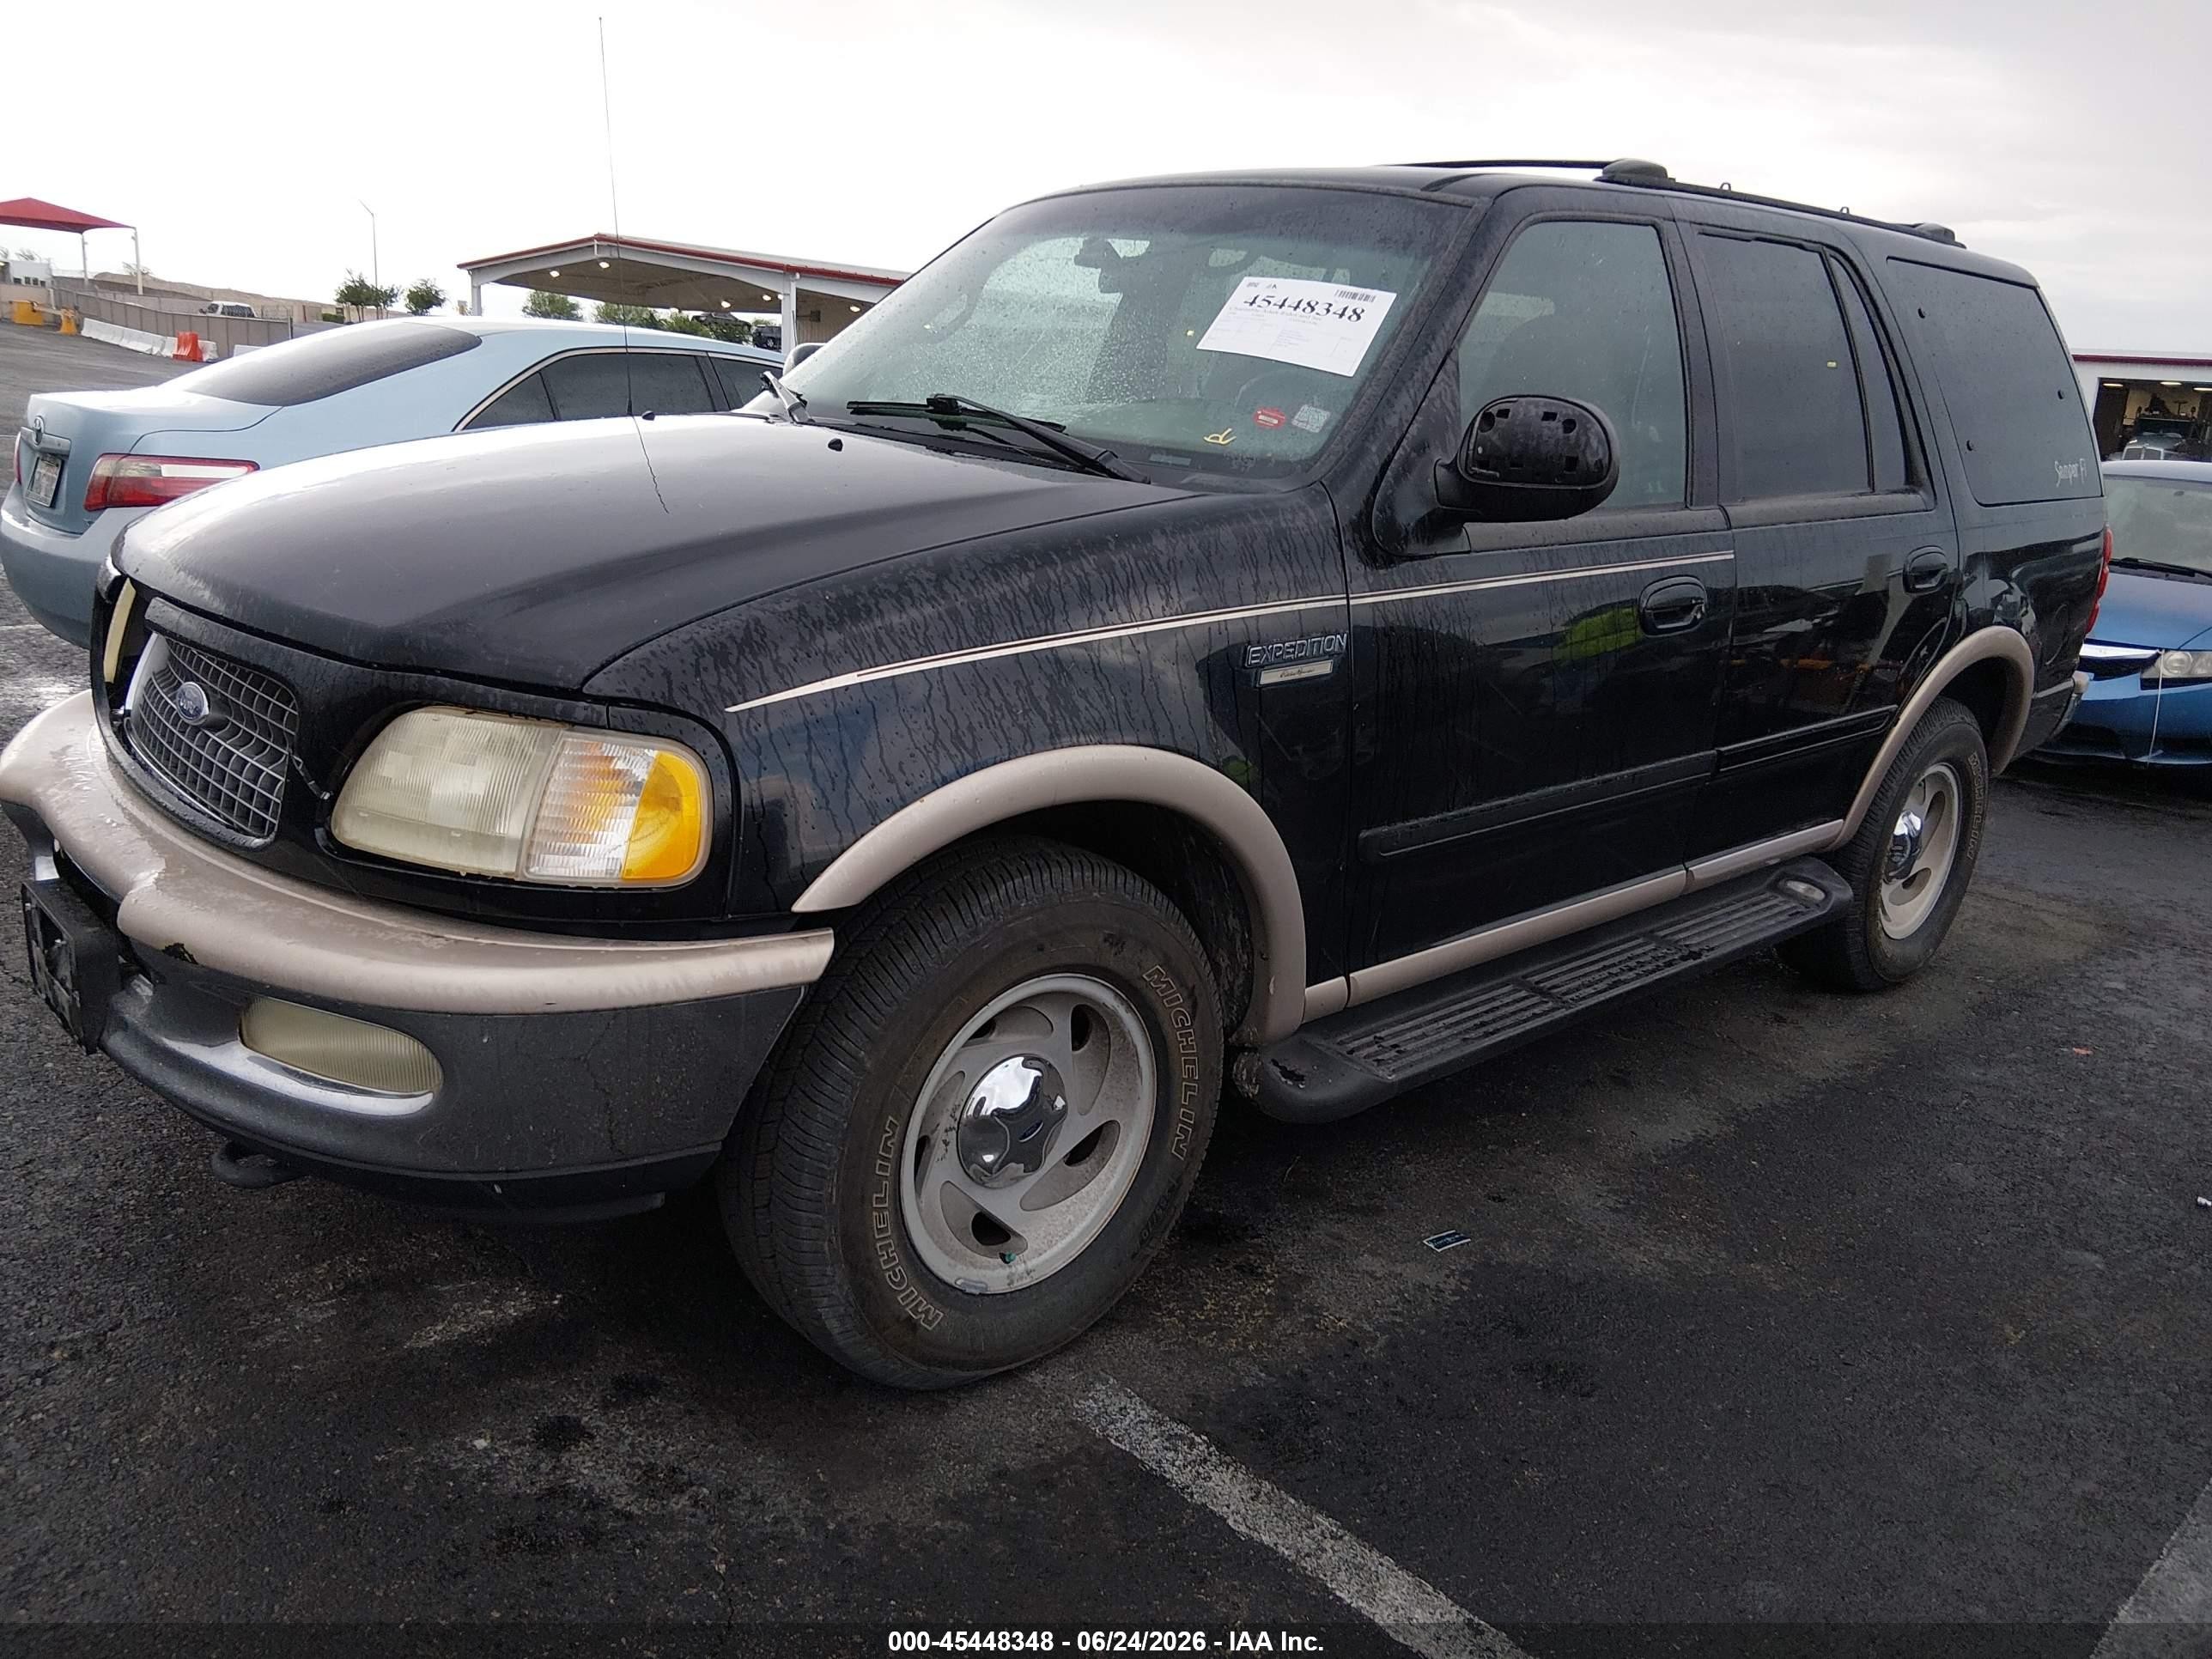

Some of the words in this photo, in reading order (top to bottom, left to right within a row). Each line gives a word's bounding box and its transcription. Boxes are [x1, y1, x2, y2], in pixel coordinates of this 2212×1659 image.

[1243, 294, 1366, 323] 45448348
[1248, 633, 1348, 665] EXPEDITION
[1142, 964, 1200, 1161] MICHELIN
[872, 1115, 945, 1331] MICHELIN
